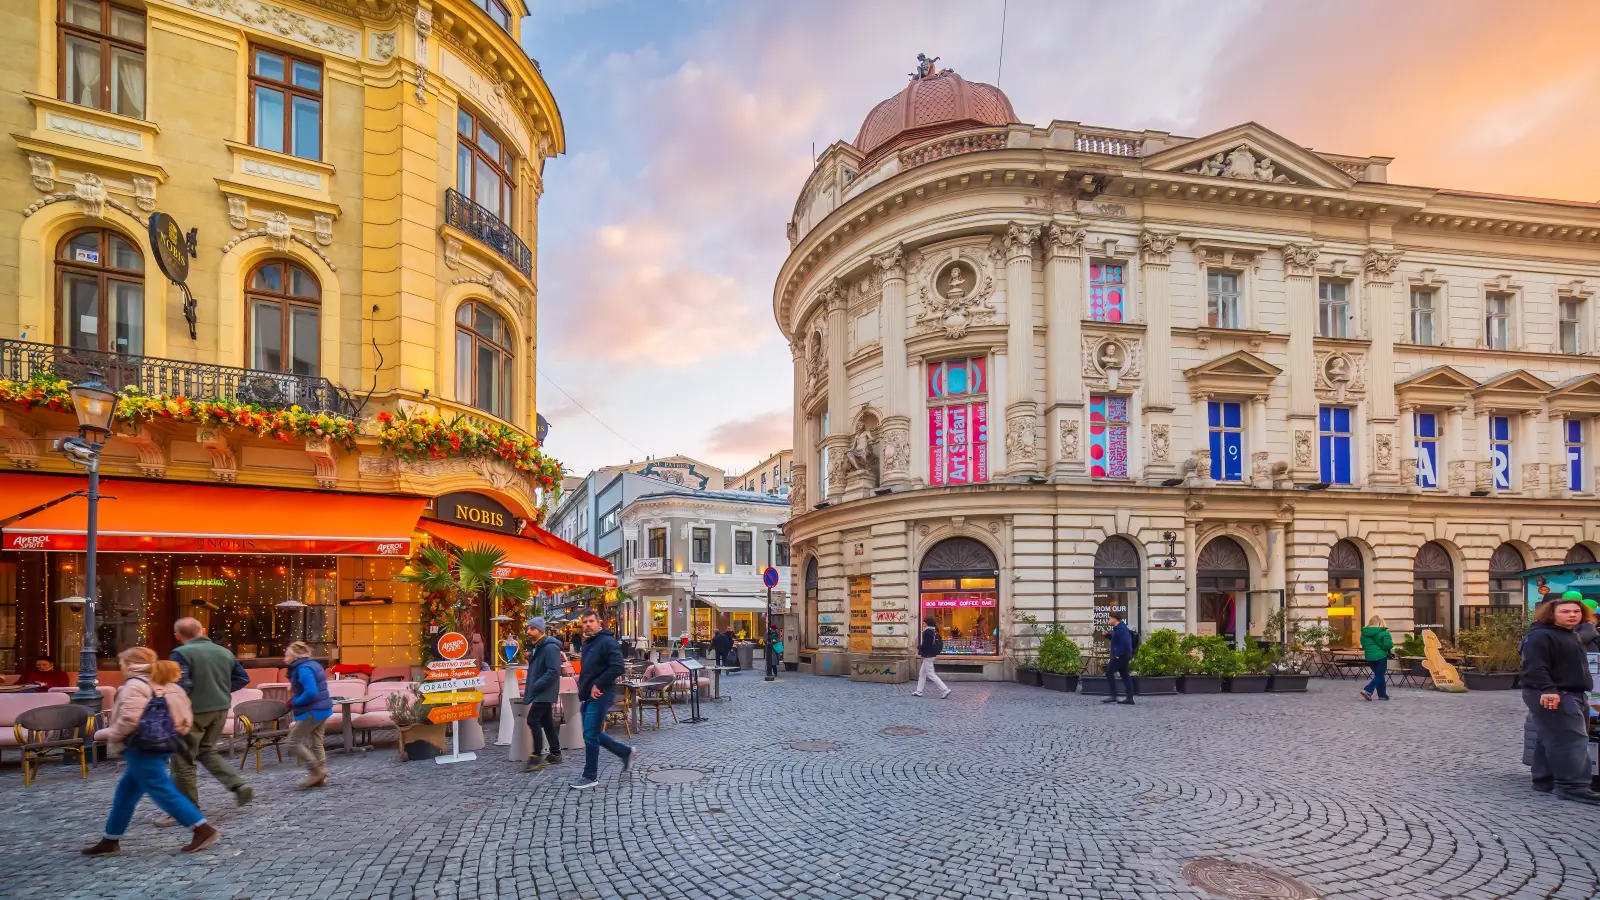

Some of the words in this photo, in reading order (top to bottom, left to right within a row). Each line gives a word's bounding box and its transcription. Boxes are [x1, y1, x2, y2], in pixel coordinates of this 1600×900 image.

[160, 231, 186, 267] NOBIS
[934, 410, 942, 427] visit
[977, 405, 986, 423] visit
[949, 408, 966, 453] Safari
[949, 455, 966, 480] Art
[456, 504, 504, 527] NOBIS
[13, 535, 51, 545] APEROL
[207, 539, 256, 549] NOBIS
[376, 542, 404, 551] APEROL
[442, 640, 464, 650] APEROL
[423, 681, 458, 691] ORANGE
